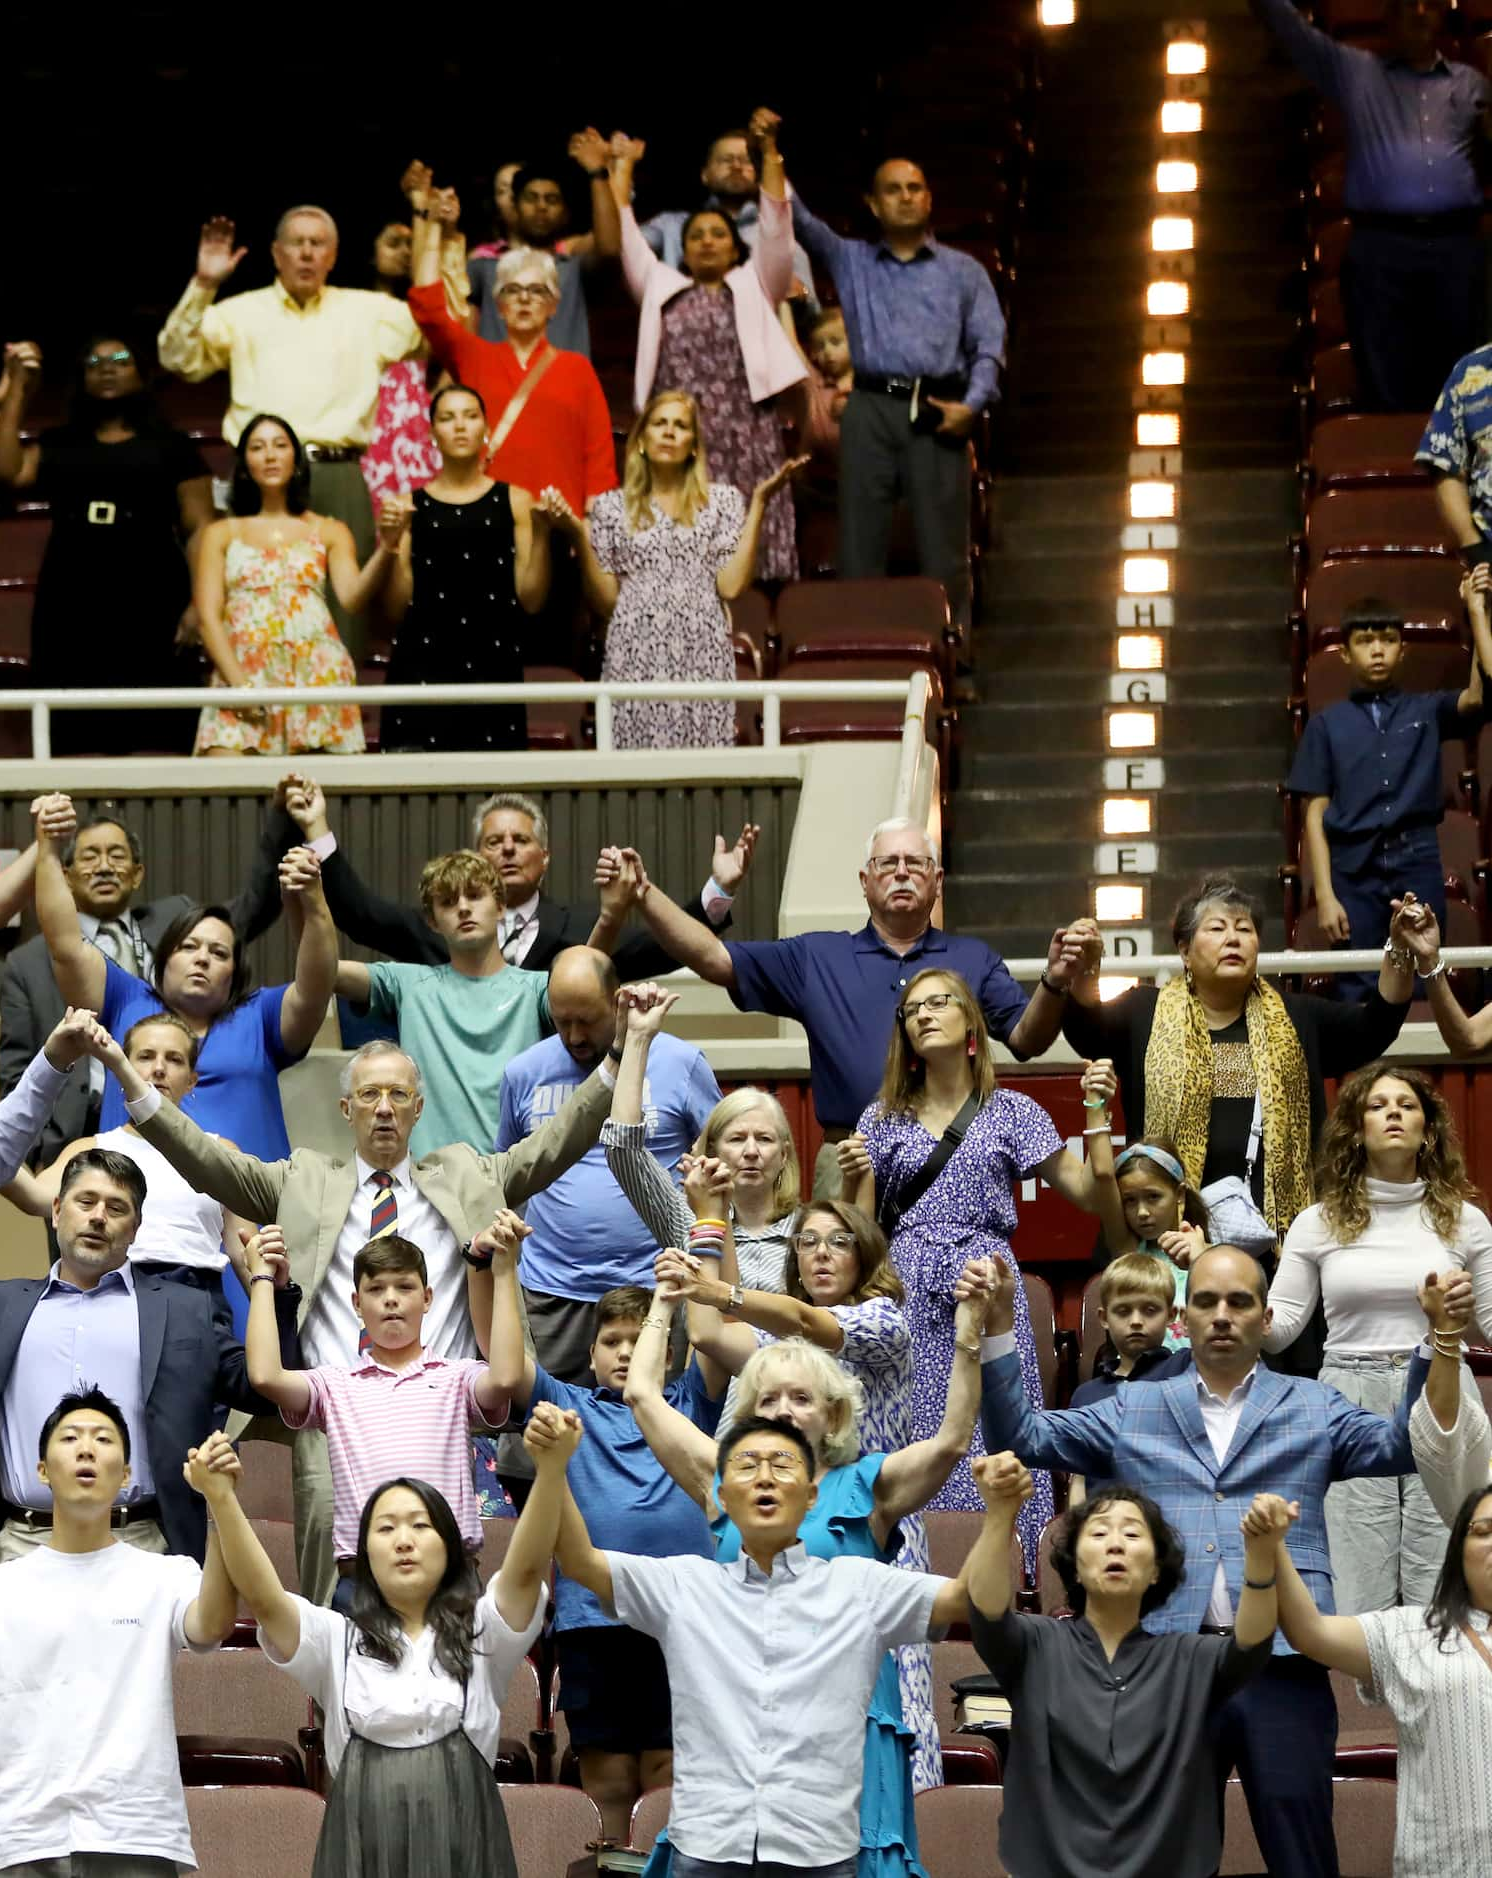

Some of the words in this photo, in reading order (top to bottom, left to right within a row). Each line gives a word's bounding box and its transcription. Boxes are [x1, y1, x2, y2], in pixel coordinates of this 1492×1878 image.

[1134, 603, 1156, 627] H
[1127, 680, 1150, 702] G
[1126, 763, 1145, 789] F
[1117, 848, 1137, 873] E
[1113, 936, 1138, 956] D
